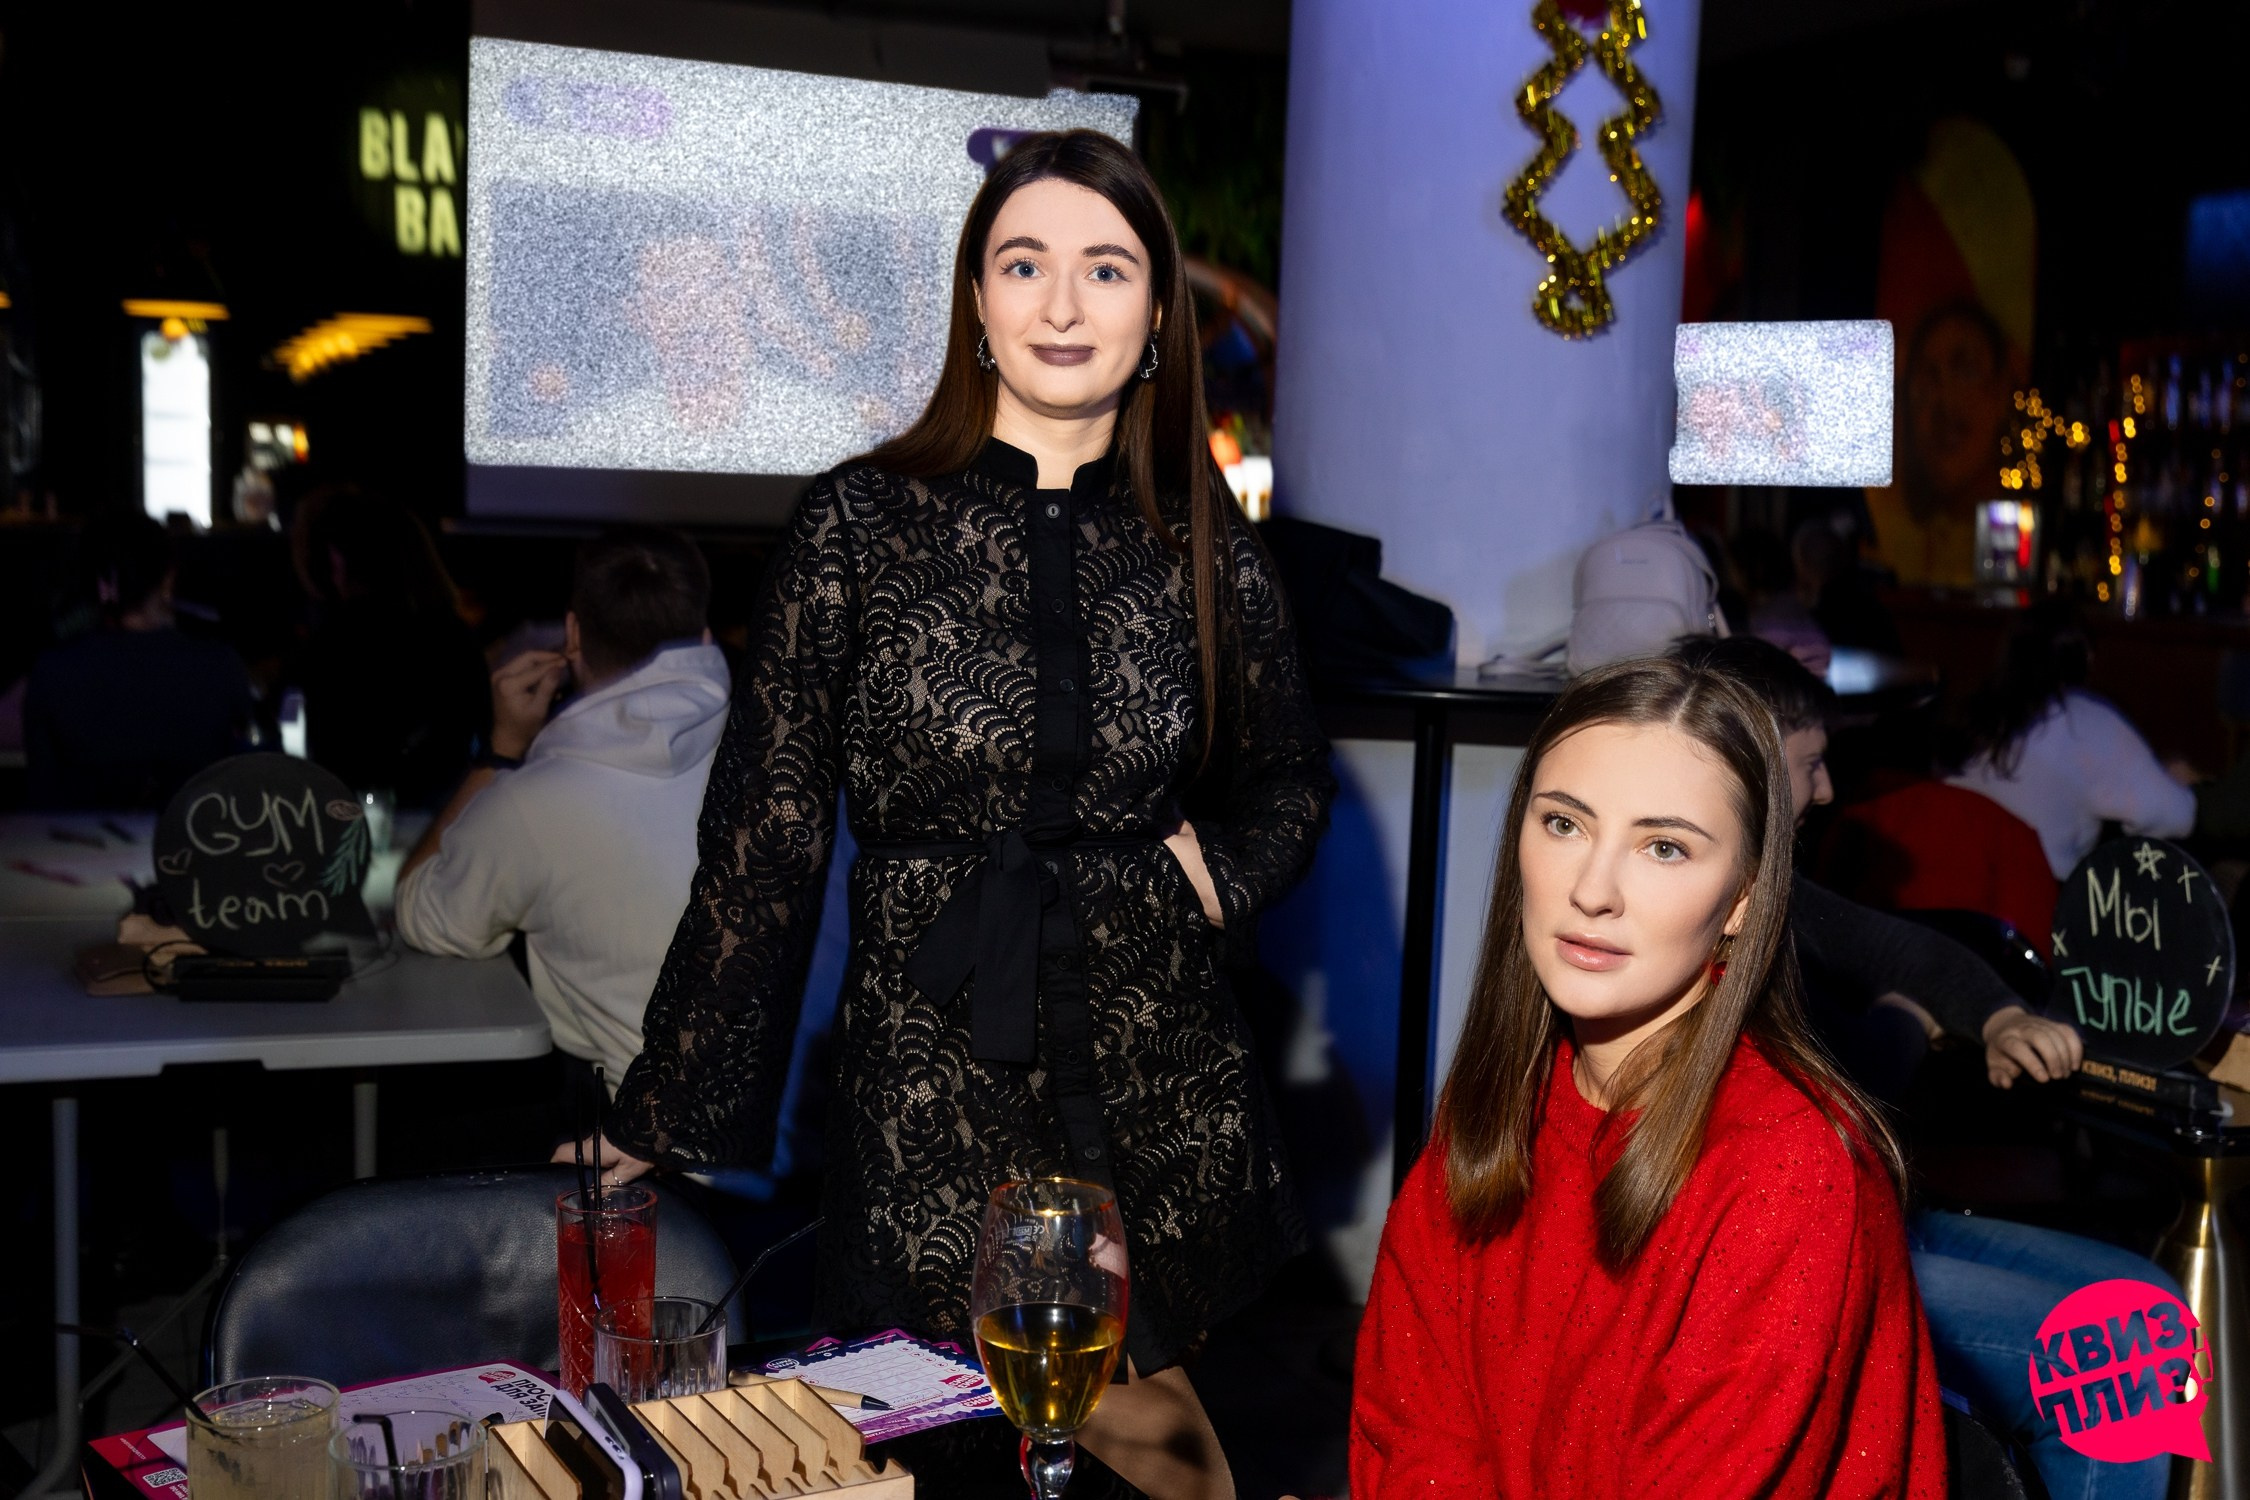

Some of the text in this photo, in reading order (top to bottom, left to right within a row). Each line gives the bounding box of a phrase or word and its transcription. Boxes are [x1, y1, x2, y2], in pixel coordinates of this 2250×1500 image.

[358, 106, 466, 184] BLA
[186, 787, 325, 857] GYM
[188, 877, 330, 930] team
[2086, 866, 2161, 951] Мы
[490, 1383, 530, 1400] ДЛЯ
[512, 1378, 551, 1405] ПРОС
